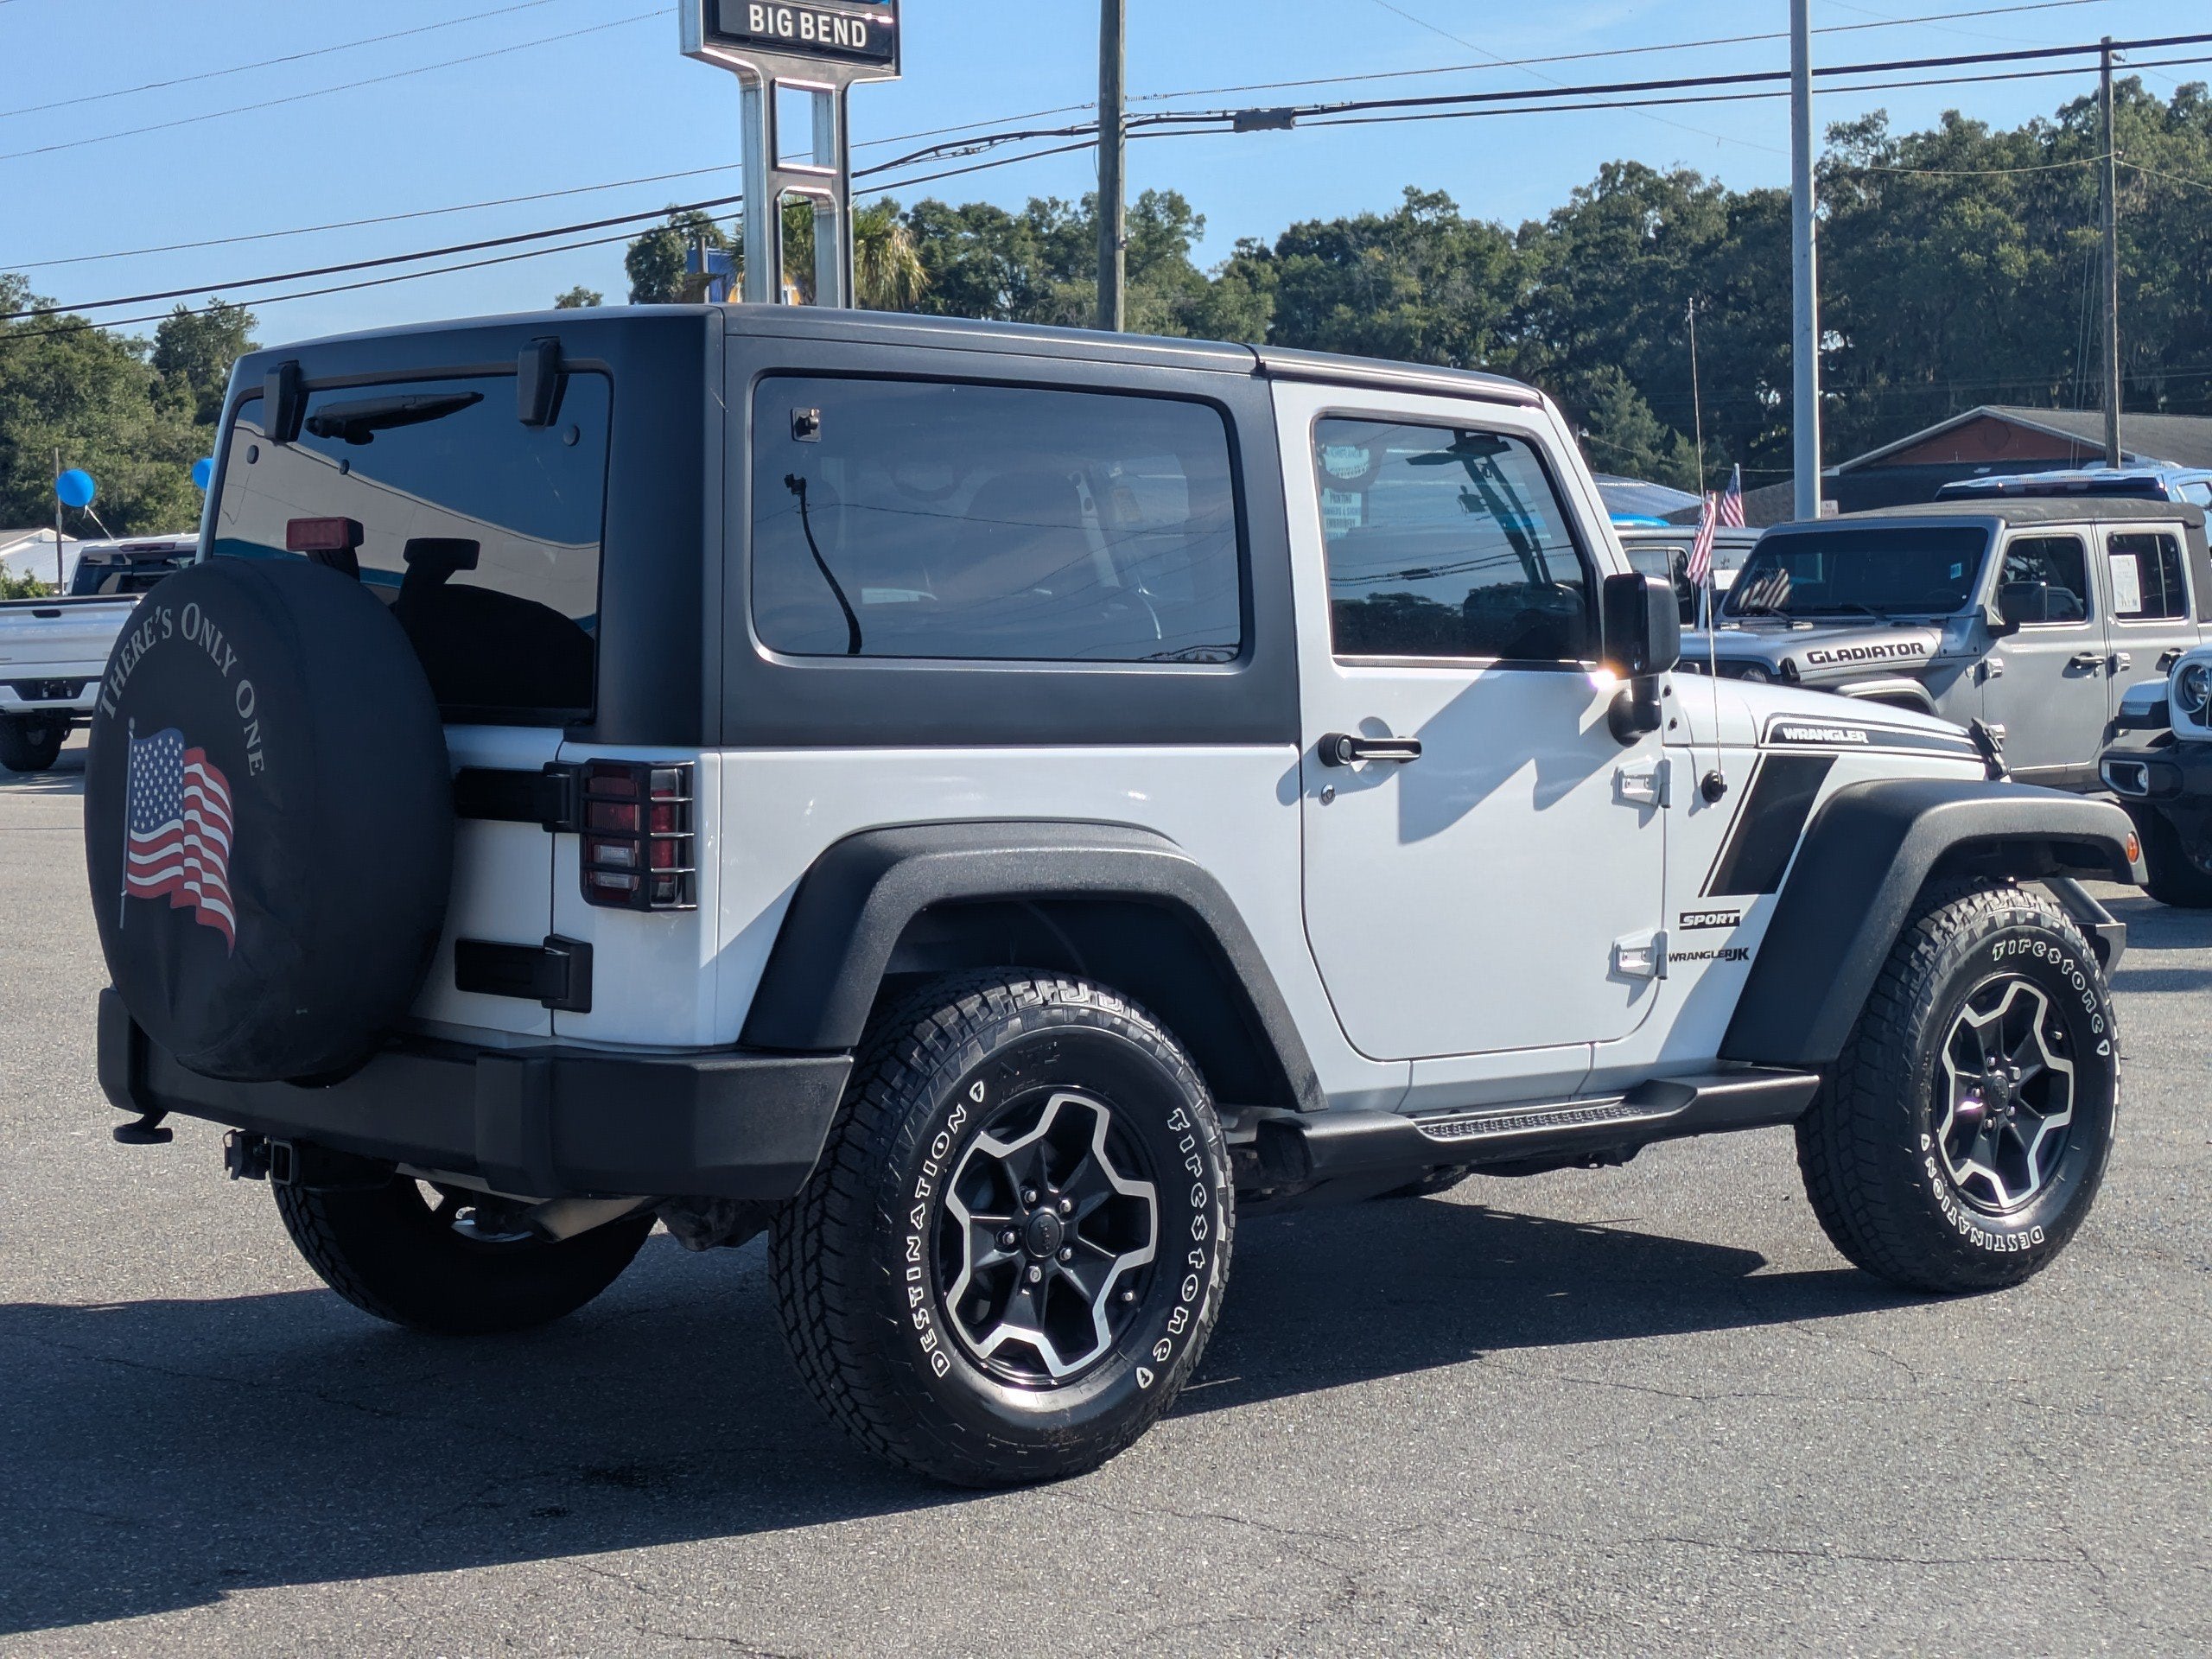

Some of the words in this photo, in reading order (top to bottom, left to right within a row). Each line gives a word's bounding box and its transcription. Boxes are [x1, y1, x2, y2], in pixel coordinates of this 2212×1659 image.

[749, 4, 792, 37] BIG
[800, 11, 868, 48] BEND
[1806, 642, 1926, 664] GLADIATOR
[99, 605, 173, 719] THERE'S
[181, 602, 238, 677] ONLY
[235, 679, 265, 777] ONE
[1782, 727, 1870, 744] WRANGLER
[1681, 912, 1740, 926] SPORT
[1924, 1156, 2045, 1252] DESTINATION
[906, 1103, 967, 1378] DESTINATION
